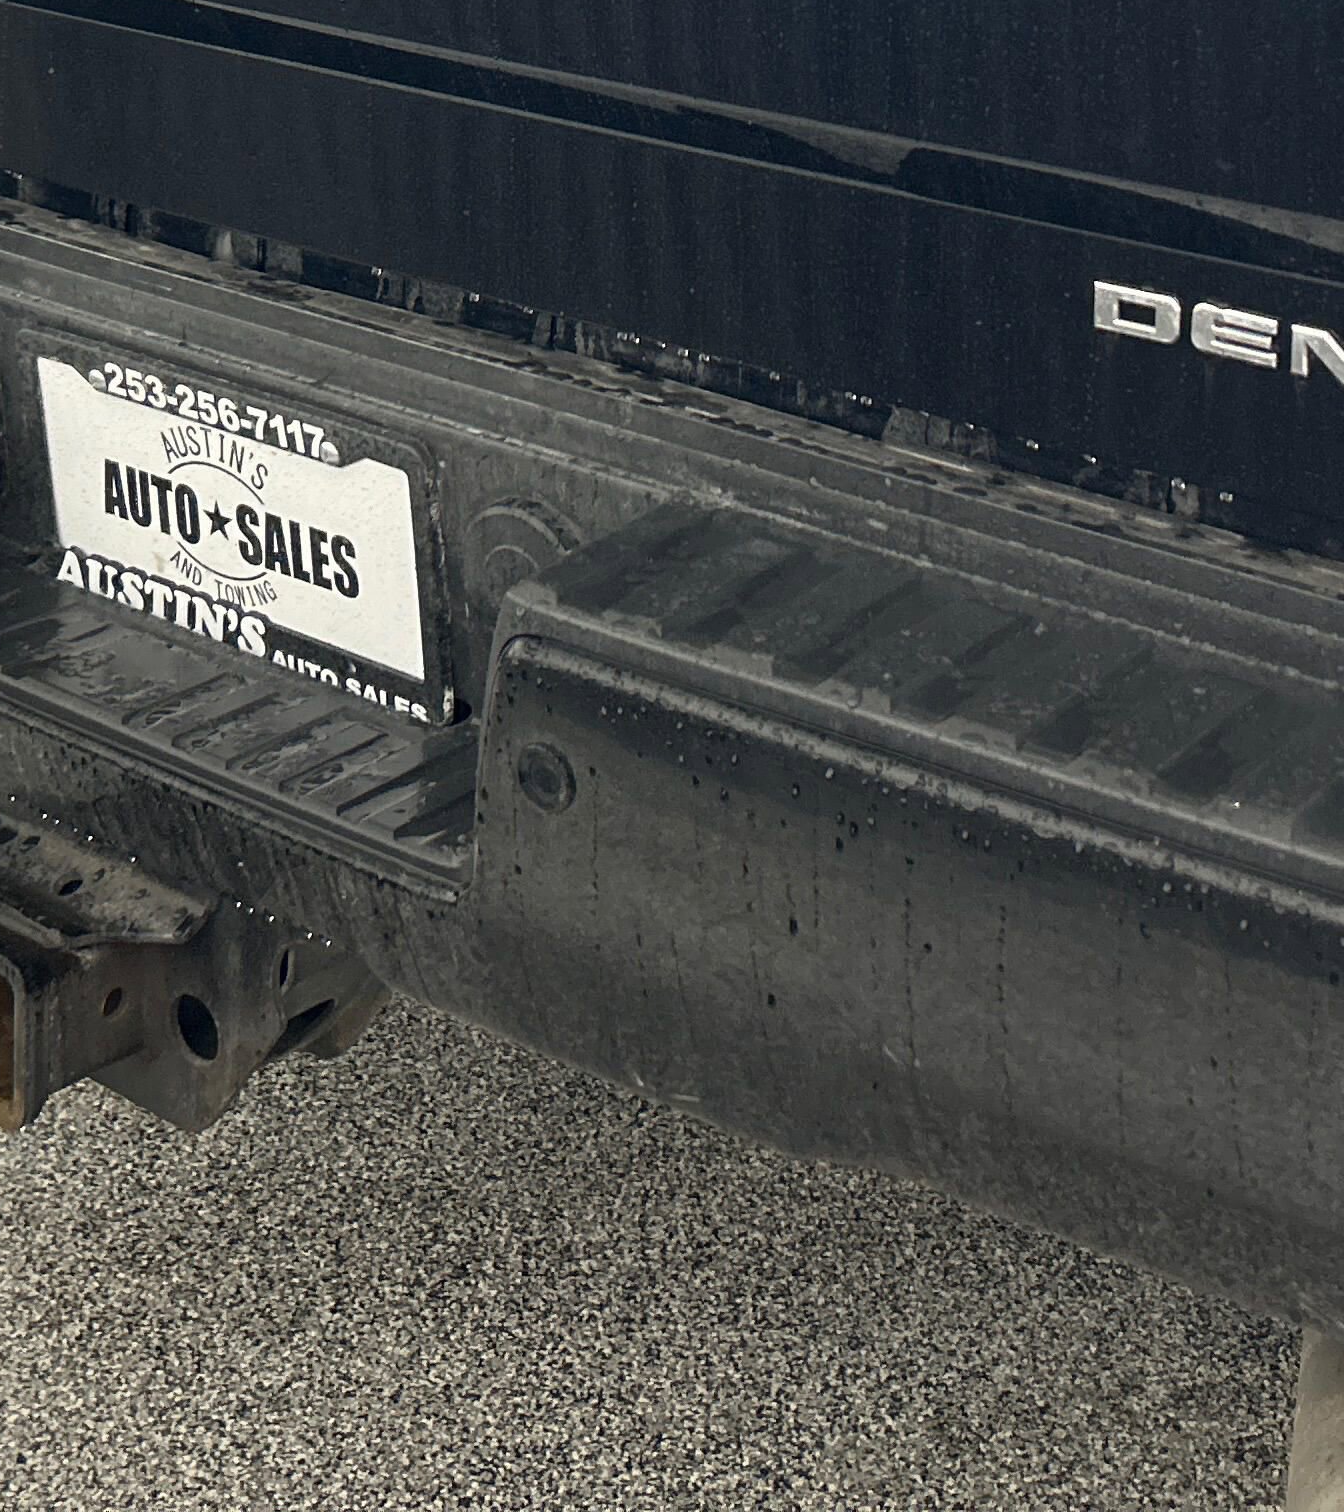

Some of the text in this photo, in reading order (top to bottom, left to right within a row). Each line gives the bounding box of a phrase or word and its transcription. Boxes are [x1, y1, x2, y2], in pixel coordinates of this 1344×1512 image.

[104, 361, 325, 459] 253-256-7117
[160, 425, 269, 490] AUSTIN'S
[104, 458, 360, 599] AUTO SALES
[56, 550, 267, 658] AUSTIN'S
[169, 550, 278, 608] AND TOWING
